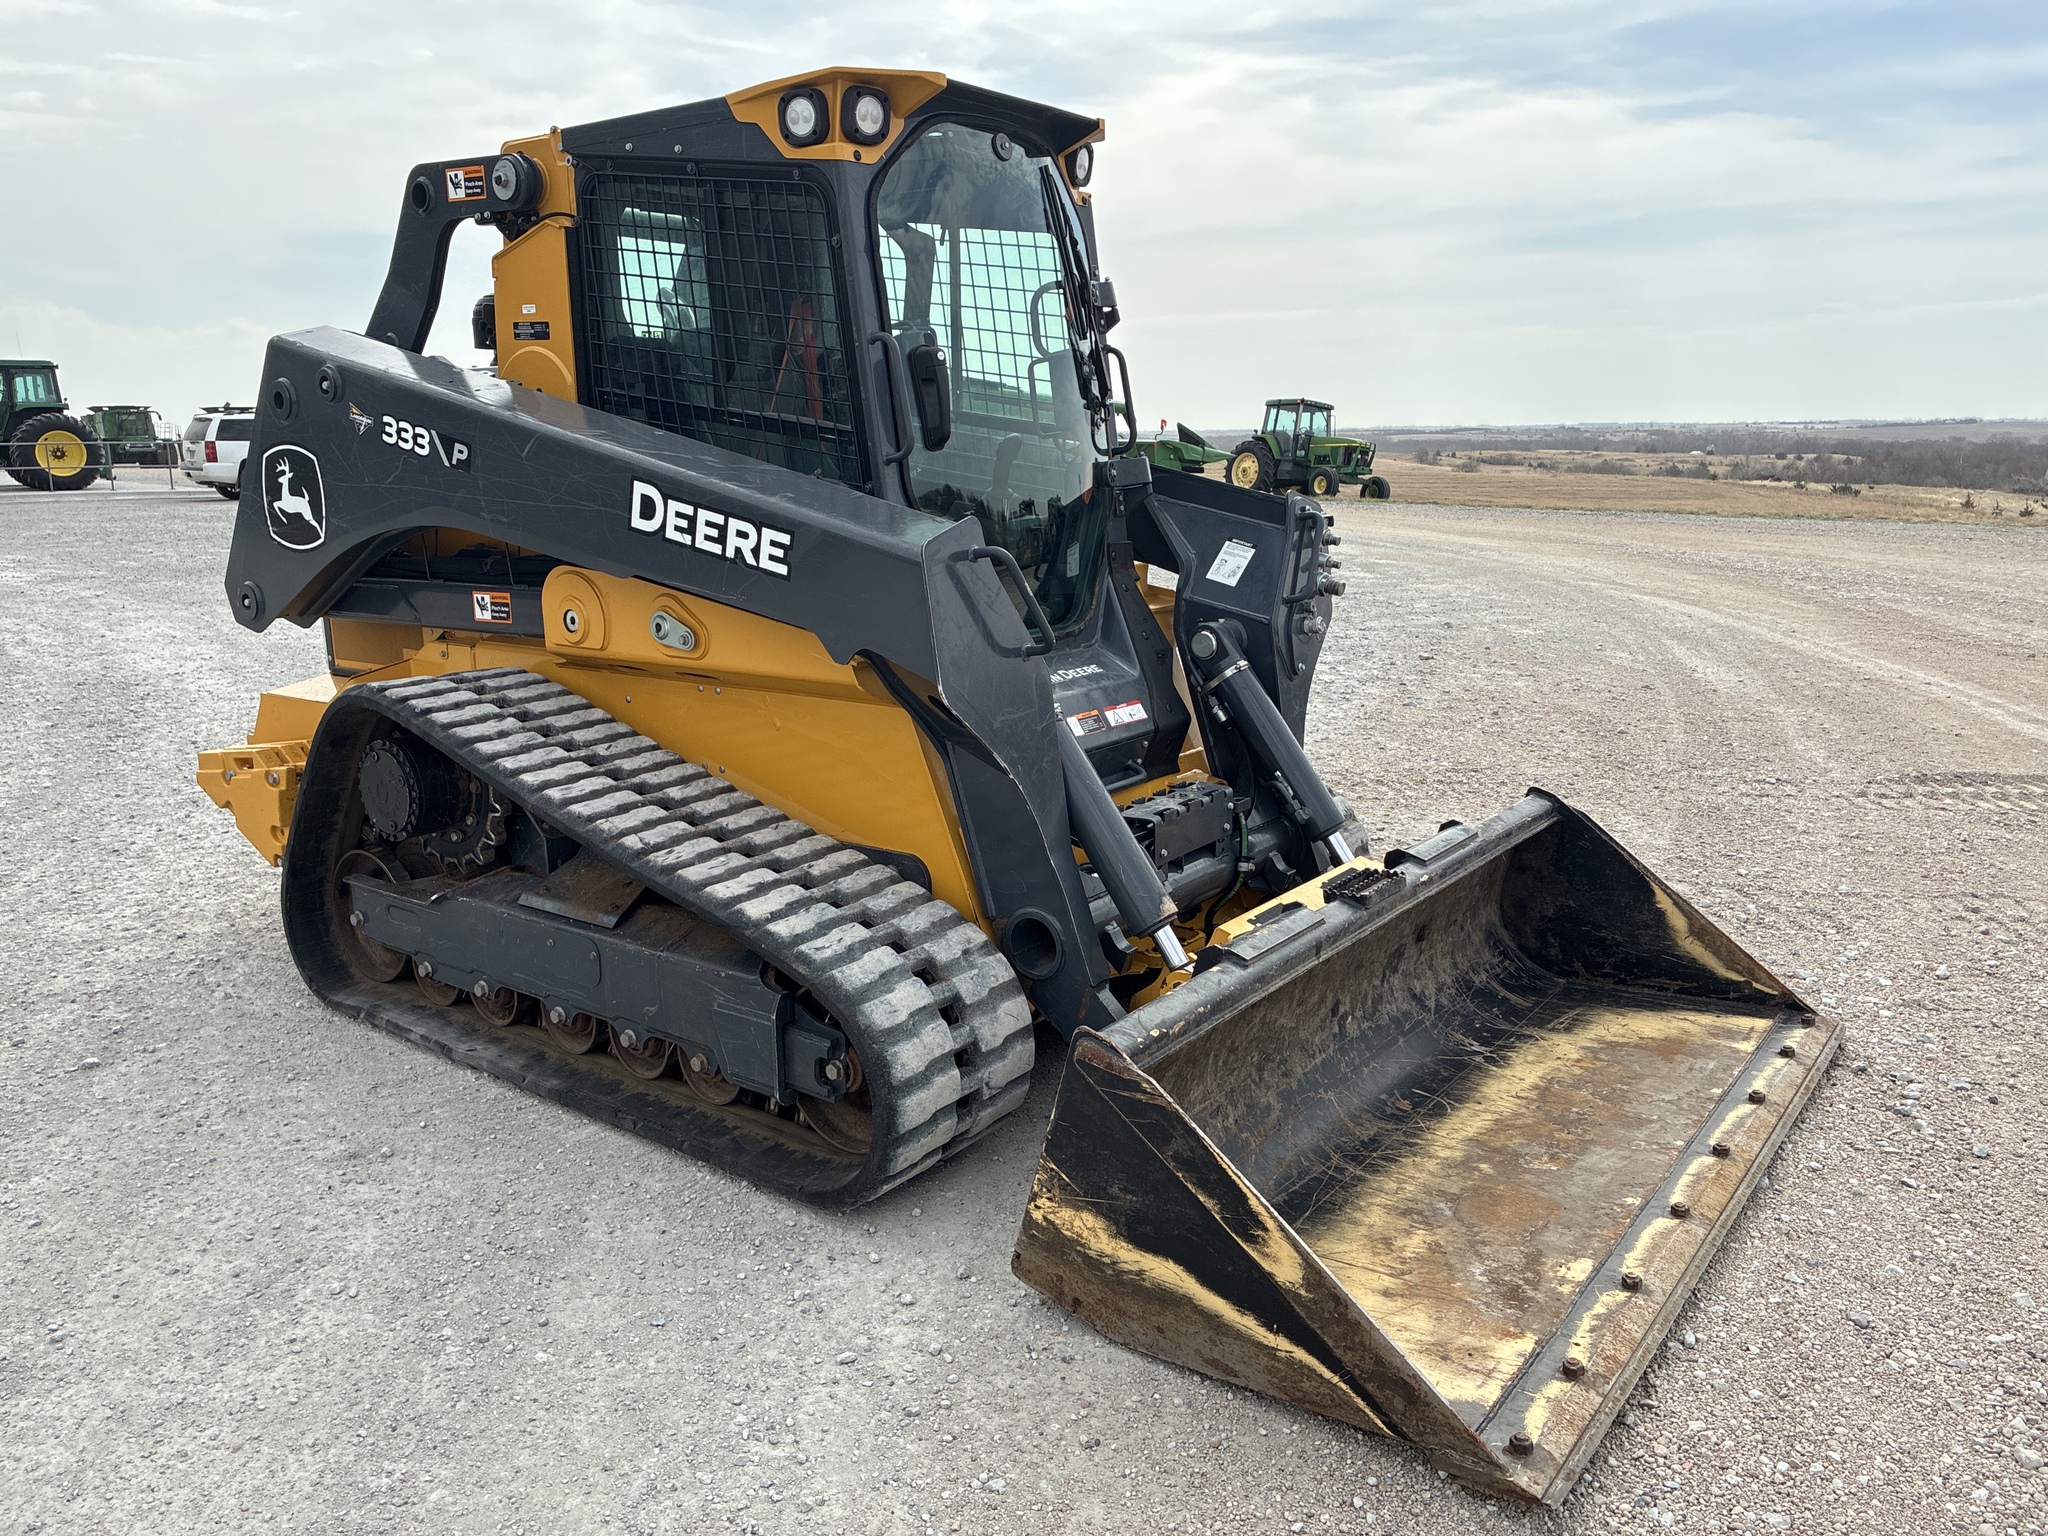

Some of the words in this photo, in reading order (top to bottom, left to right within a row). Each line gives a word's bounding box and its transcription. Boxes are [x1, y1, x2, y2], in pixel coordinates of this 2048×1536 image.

[382, 415, 430, 456] 333
[631, 480, 791, 576] DEERE
[1057, 664, 1103, 679] DEERE
